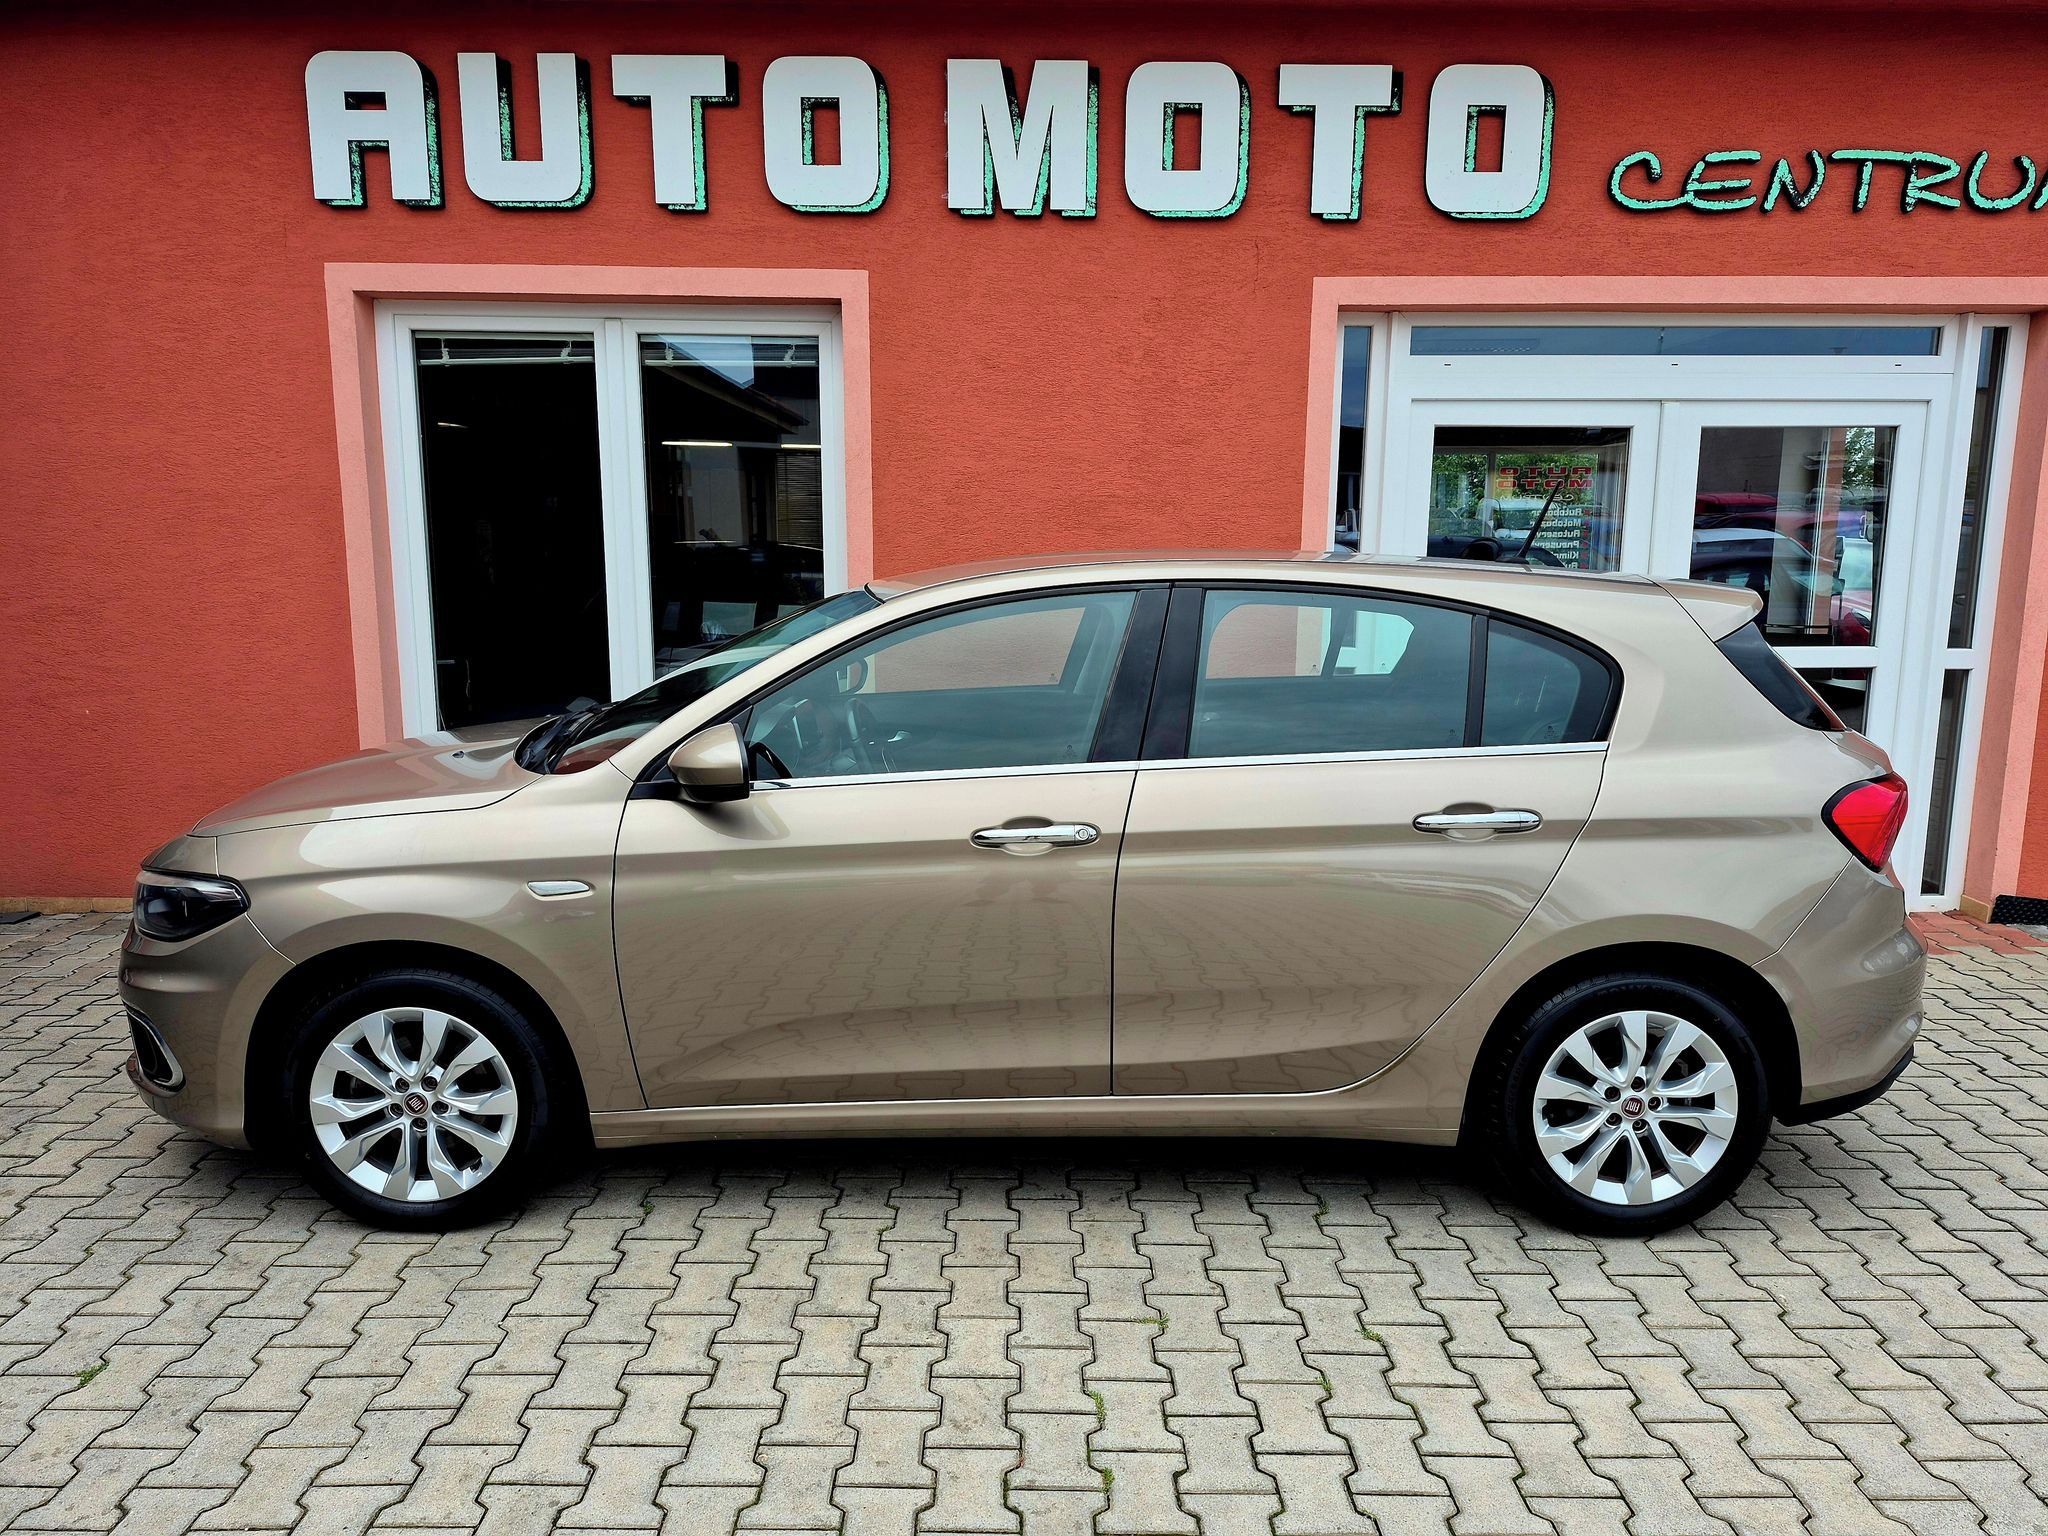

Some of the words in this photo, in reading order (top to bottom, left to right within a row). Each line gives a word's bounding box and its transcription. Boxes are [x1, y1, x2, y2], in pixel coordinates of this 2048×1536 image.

[304, 50, 891, 215] AUTO
[945, 58, 1556, 222] MOTO
[1608, 148, 2048, 215] CENTRU
